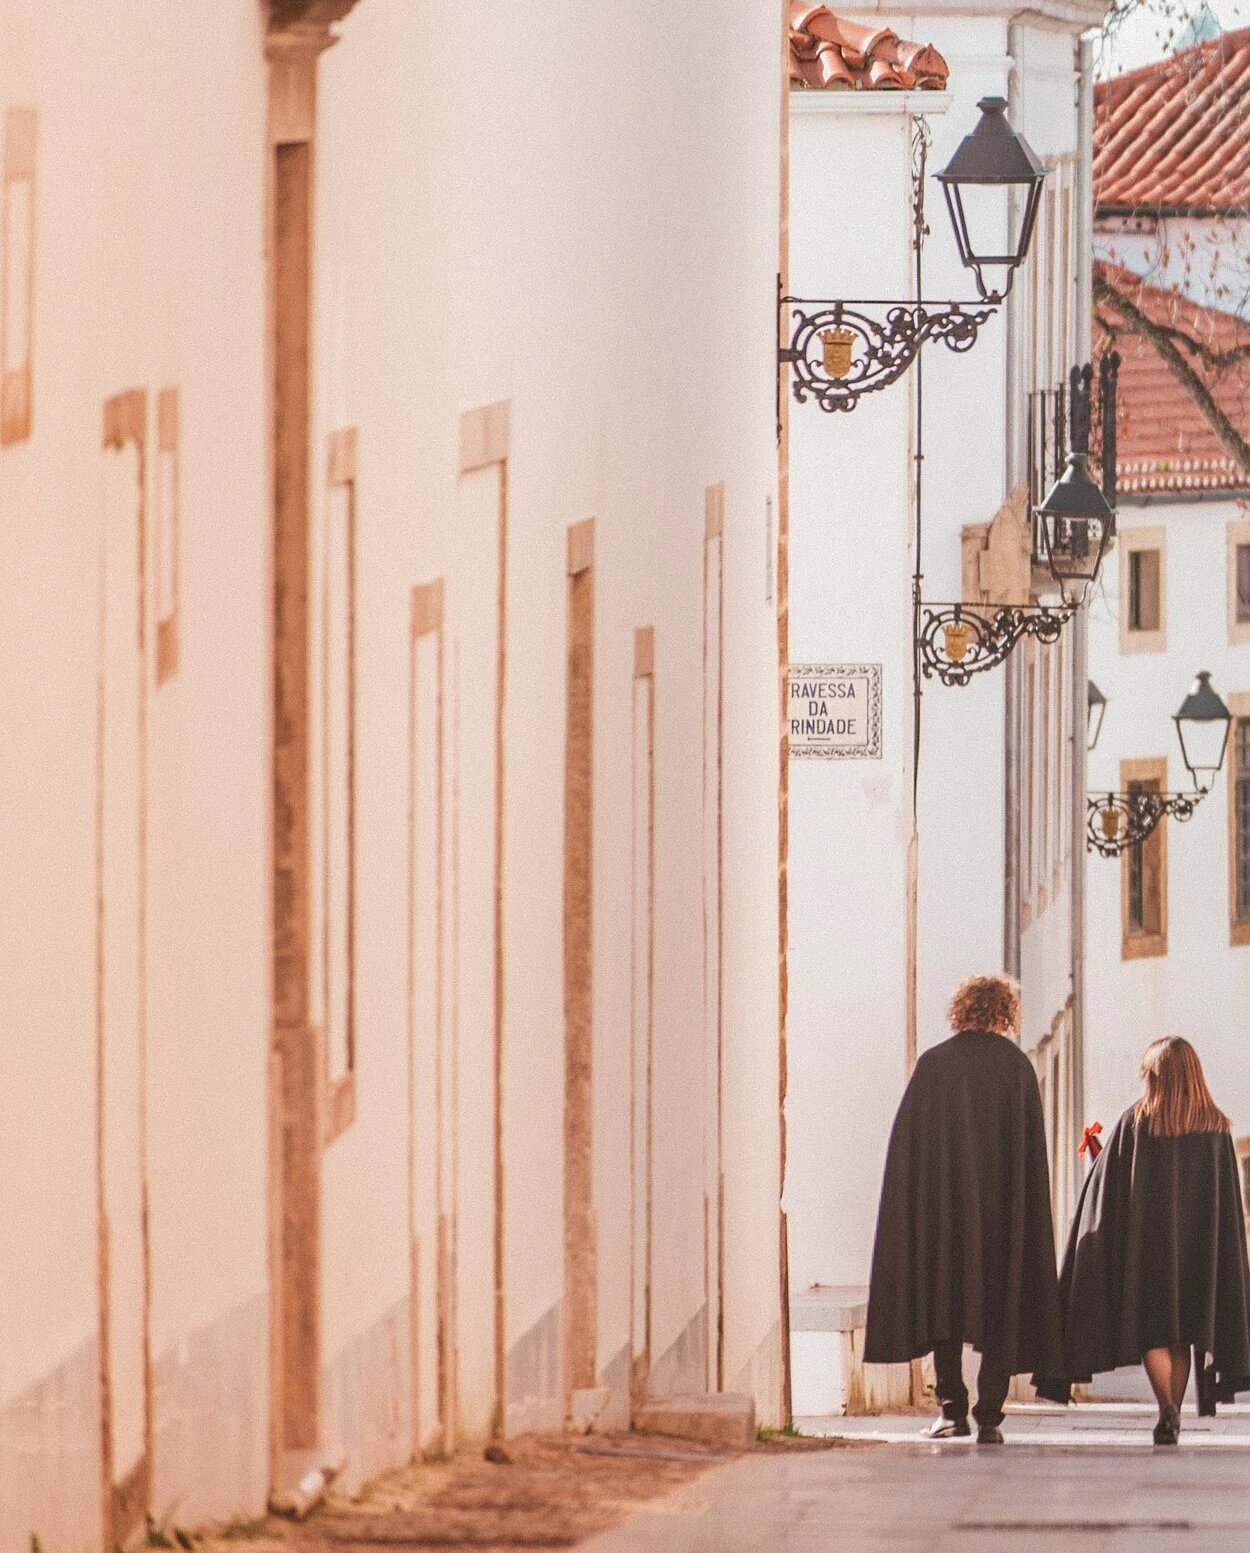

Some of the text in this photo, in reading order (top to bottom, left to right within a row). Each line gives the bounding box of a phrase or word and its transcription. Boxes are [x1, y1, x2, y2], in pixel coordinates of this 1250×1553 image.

[787, 683, 856, 698] RAVESSA
[808, 701, 828, 716] DA
[787, 719, 857, 735] RINDADE
